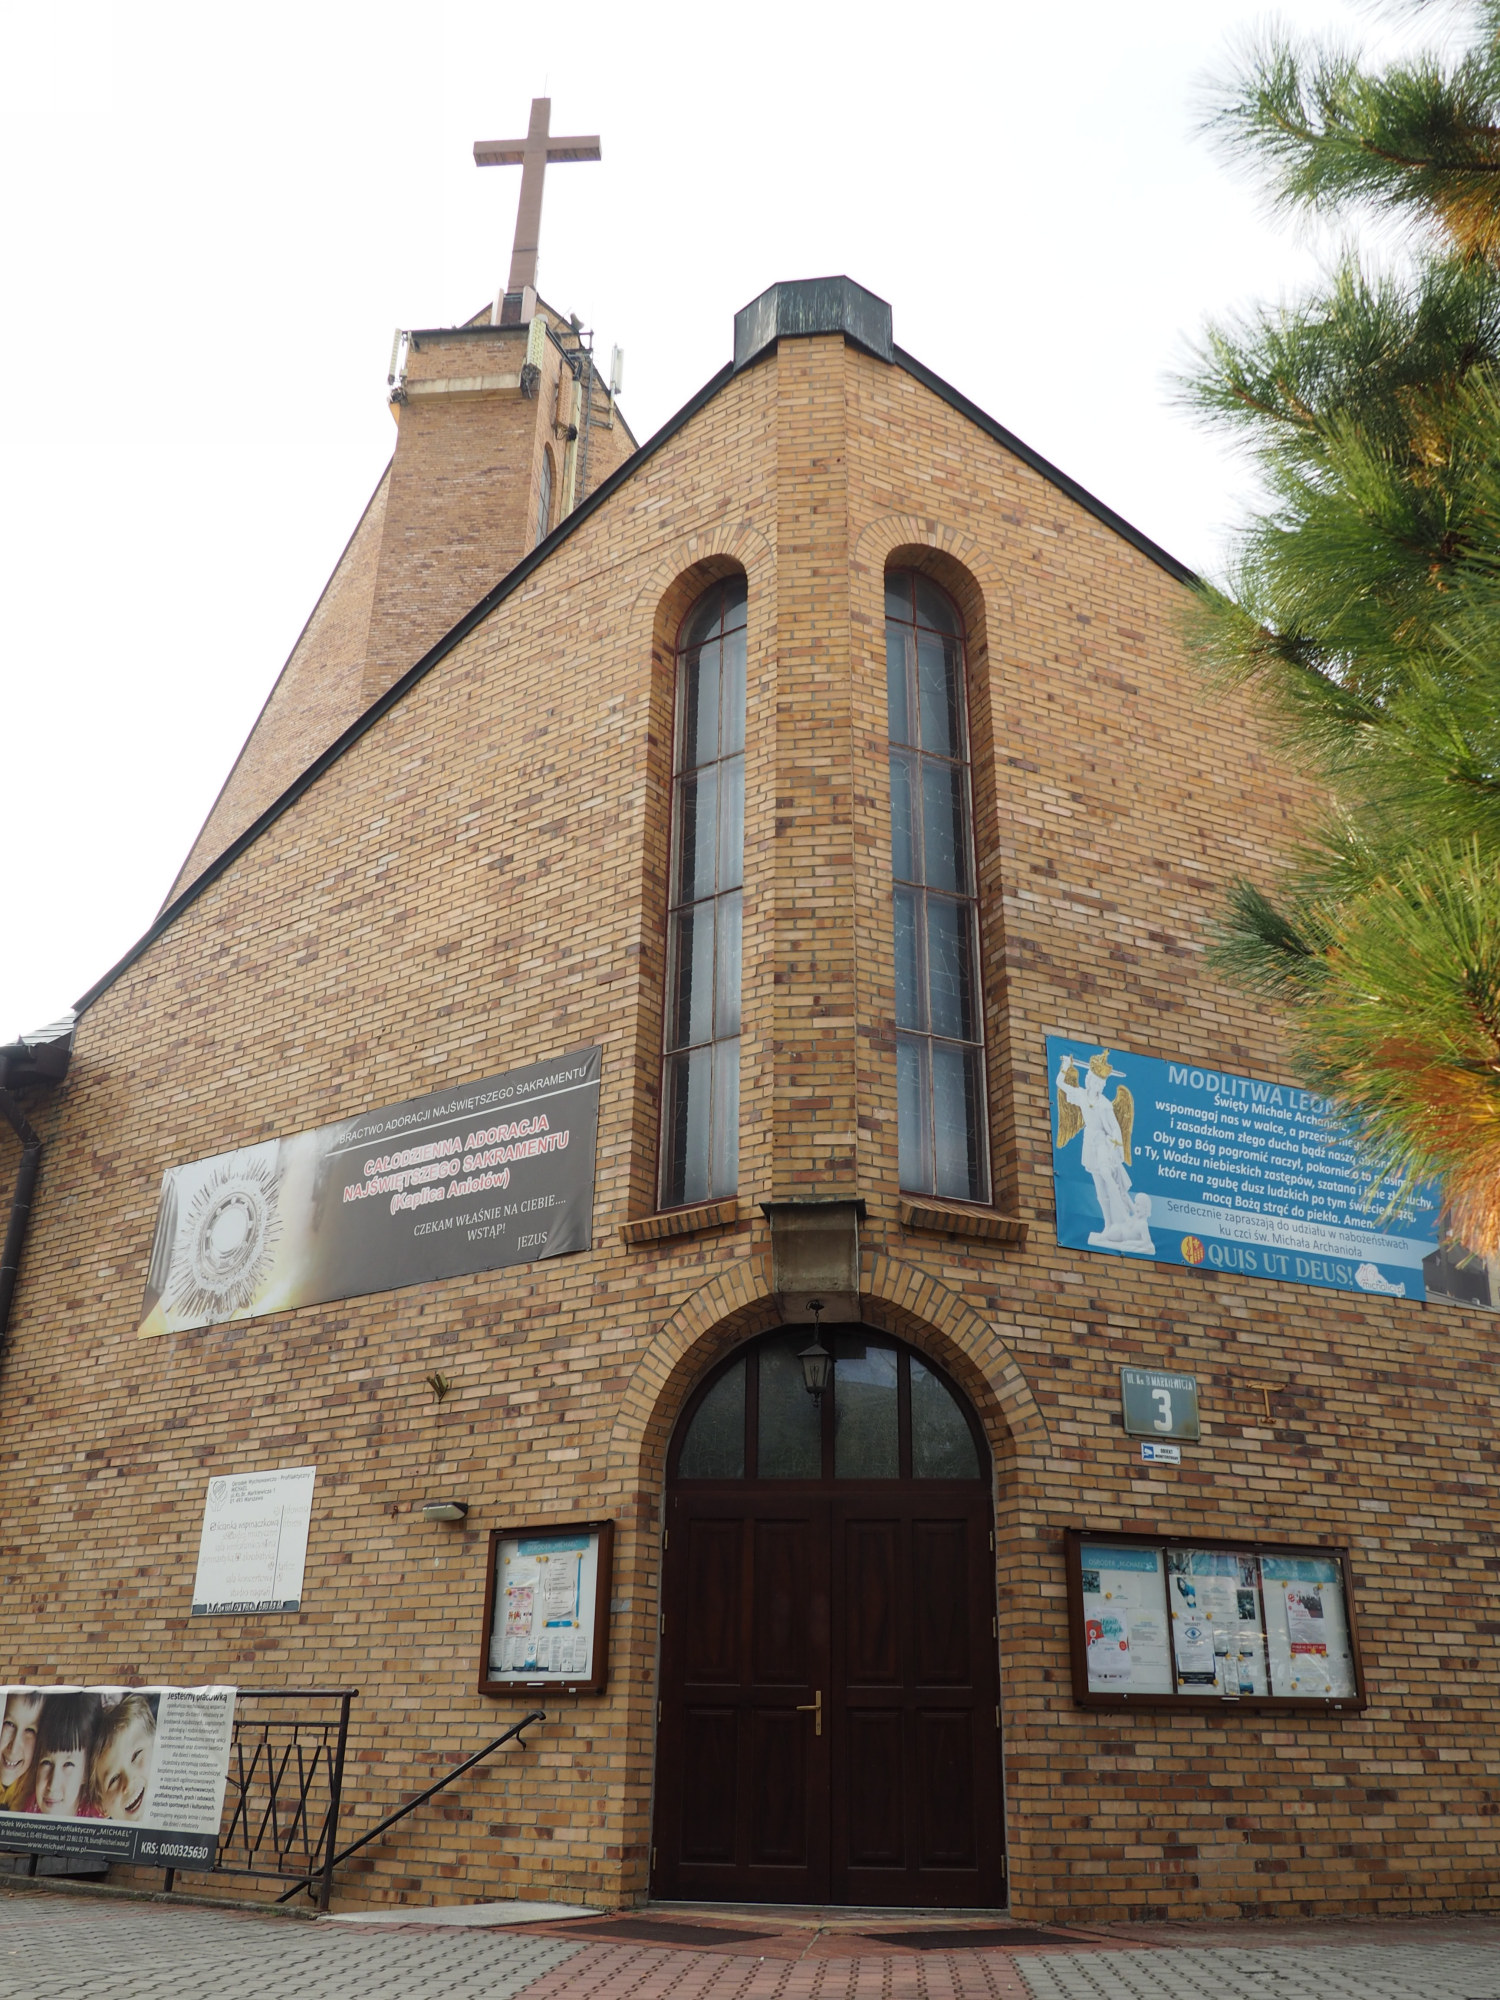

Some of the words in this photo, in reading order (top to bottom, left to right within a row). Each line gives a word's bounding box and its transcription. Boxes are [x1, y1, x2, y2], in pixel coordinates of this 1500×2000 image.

[339, 1123, 384, 1144] BRACTWO
[384, 1110, 431, 1132] ADORACJI
[432, 1086, 514, 1118] NAJŚWIĘTSZEGO
[516, 1066, 587, 1096] SAKRAMENTU
[1168, 1065, 1283, 1106] MODLITWA
[1214, 1093, 1249, 1114] Święty
[1251, 1103, 1292, 1121] Michale
[1155, 1100, 1218, 1124] wspomagaj
[1220, 1114, 1239, 1125] nas
[1241, 1119, 1251, 1128] w
[1253, 1120, 1286, 1137] walce,
[1289, 1128, 1296, 1137] a
[1298, 1129, 1336, 1144] przeciw
[1170, 1118, 1174, 1128] i
[1176, 1121, 1235, 1141] zasadzkom
[1237, 1133, 1266, 1148] złego
[1267, 1138, 1299, 1152] ducha
[1301, 1143, 1326, 1159] bądź
[1328, 1151, 1356, 1166] naszą
[343, 1159, 461, 1203] NAJŚWIĘTSZEGO
[463, 1130, 569, 1173] SAKRAMENTU
[363, 1136, 463, 1177] CAŁODZIENNA
[464, 1114, 549, 1151] ADORACJA
[1153, 1131, 1175, 1147] Oby
[1178, 1137, 1192, 1149] go
[1194, 1139, 1216, 1155] Bóg
[1218, 1147, 1268, 1164] pogromić
[1270, 1155, 1303, 1171] raczył,
[1306, 1162, 1350, 1179] pokornie
[1351, 1170, 1359, 1179] o
[1361, 1170, 1372, 1181] to
[390, 1187, 445, 1216] (Kaplica
[446, 1168, 510, 1199] Aniołów)
[1134, 1146, 1141, 1155] a
[1145, 1146, 1160, 1161] Ty,
[1163, 1149, 1200, 1166] Wodzu
[1203, 1159, 1262, 1178] niebieskich
[1264, 1170, 1315, 1187] zastępów,
[1317, 1180, 1356, 1195] szatana
[1358, 1185, 1362, 1196] i
[1158, 1165, 1187, 1180] które
[1190, 1174, 1204, 1183] na
[1206, 1176, 1238, 1192] zgubę
[1241, 1180, 1265, 1195] dusz
[1267, 1185, 1308, 1203] ludzkich
[1311, 1194, 1325, 1206] po
[1327, 1196, 1347, 1210] tym
[413, 1217, 454, 1236] CZEKAM
[455, 1206, 502, 1227] WŁAŚNIE
[503, 1203, 518, 1217] NA
[467, 1223, 506, 1241] WSTĄP!
[1167, 1200, 1222, 1220] Serdecznie
[1224, 1212, 1275, 1230] zapraszają
[1277, 1220, 1290, 1231] do
[1292, 1224, 1326, 1237] udziału
[1328, 1230, 1337, 1239] w
[1339, 1231, 1409, 1251] nabożeństwach
[1202, 1192, 1232, 1208] mocą
[1235, 1196, 1260, 1213] Bożą
[1263, 1202, 1289, 1217] strąć
[1291, 1205, 1305, 1217] do
[1306, 1209, 1341, 1224] piekła.
[1343, 1215, 1376, 1230] Amen.
[516, 1231, 548, 1252] JEZUS
[1219, 1224, 1231, 1236] ku
[1234, 1228, 1251, 1240] czci
[1254, 1231, 1270, 1242] św.
[1272, 1233, 1310, 1249] Michała
[1312, 1240, 1363, 1258] Archanioła
[1207, 1243, 1258, 1271] QUIS
[1263, 1252, 1290, 1276] UT
[1295, 1257, 1354, 1286] DEUS!
[1151, 1388, 1173, 1432] 3
[27, 1842, 87, 1854] www.michael.waw.pl
[141, 1841, 159, 1854] KRS:
[160, 1843, 209, 1859] 0000325630
